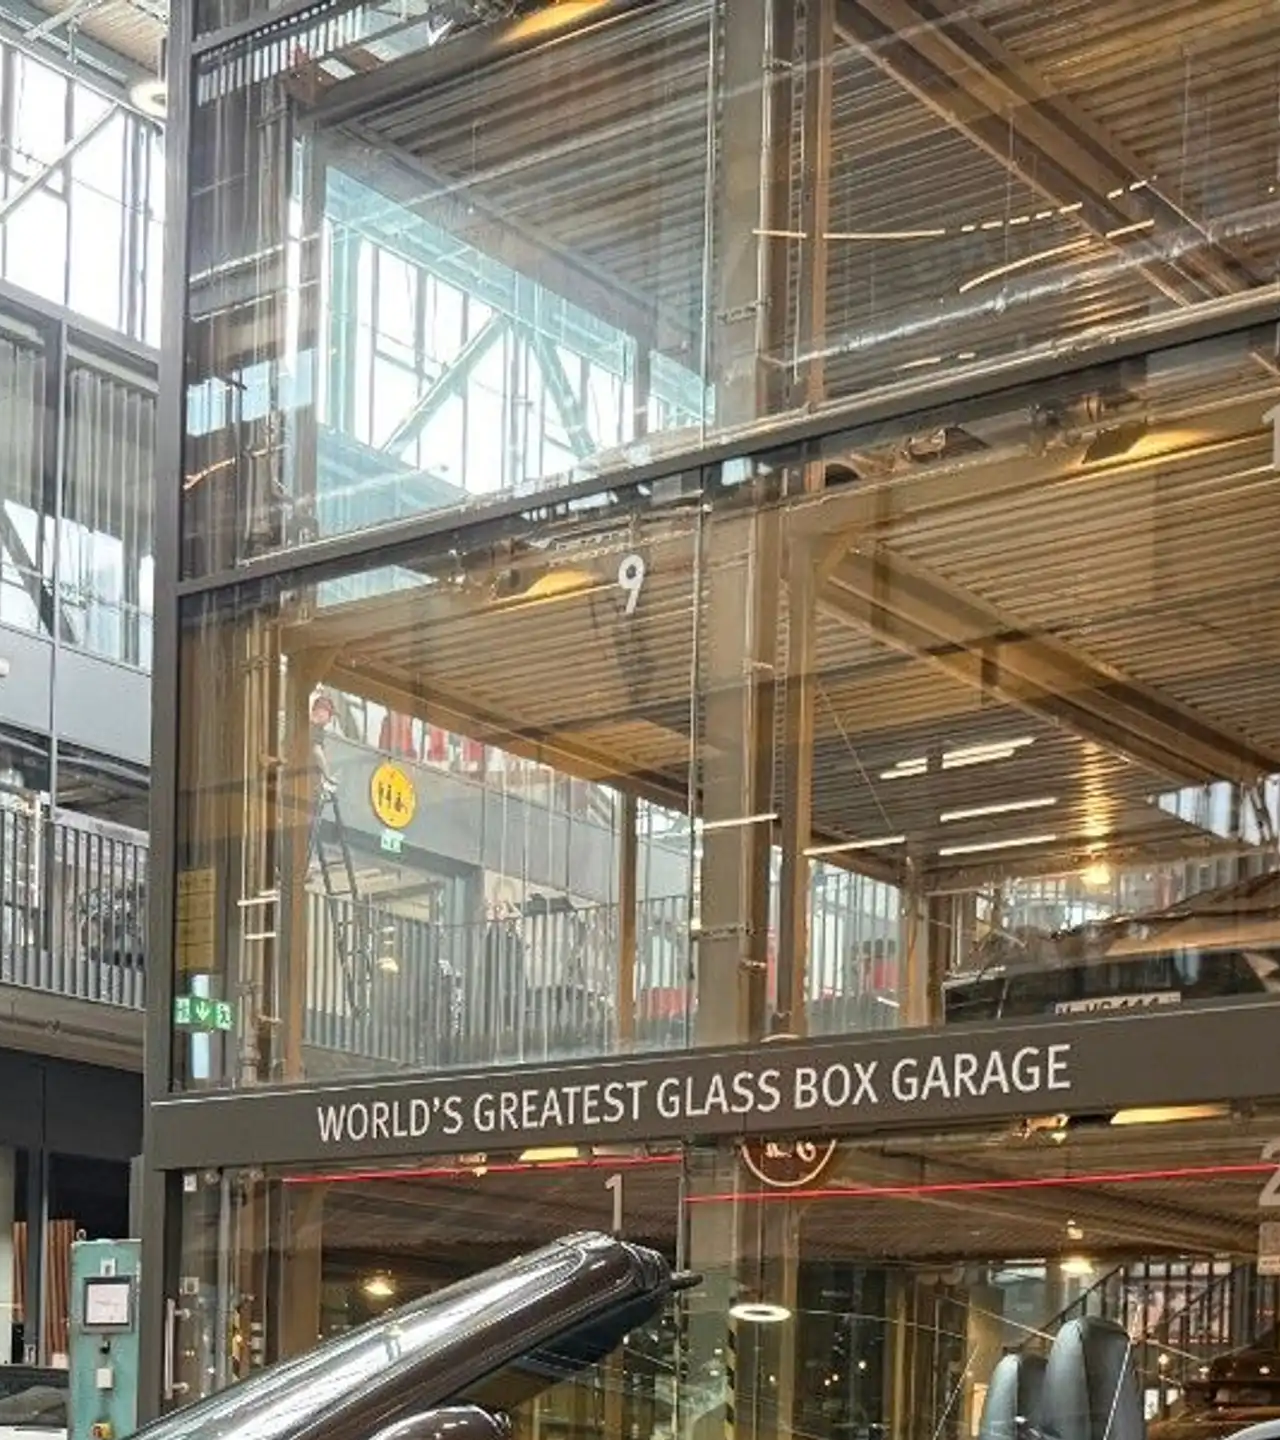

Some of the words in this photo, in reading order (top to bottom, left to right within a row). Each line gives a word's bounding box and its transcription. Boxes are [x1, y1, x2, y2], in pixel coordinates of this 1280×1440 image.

[618, 554, 644, 613] 9
[317, 1095, 464, 1142] WORLD'S
[473, 1080, 648, 1132] GREATEST
[656, 1070, 781, 1119] GLASS
[794, 1061, 879, 1110] BOX
[891, 1043, 1072, 1101] GARAGE
[604, 1173, 622, 1232] 1
